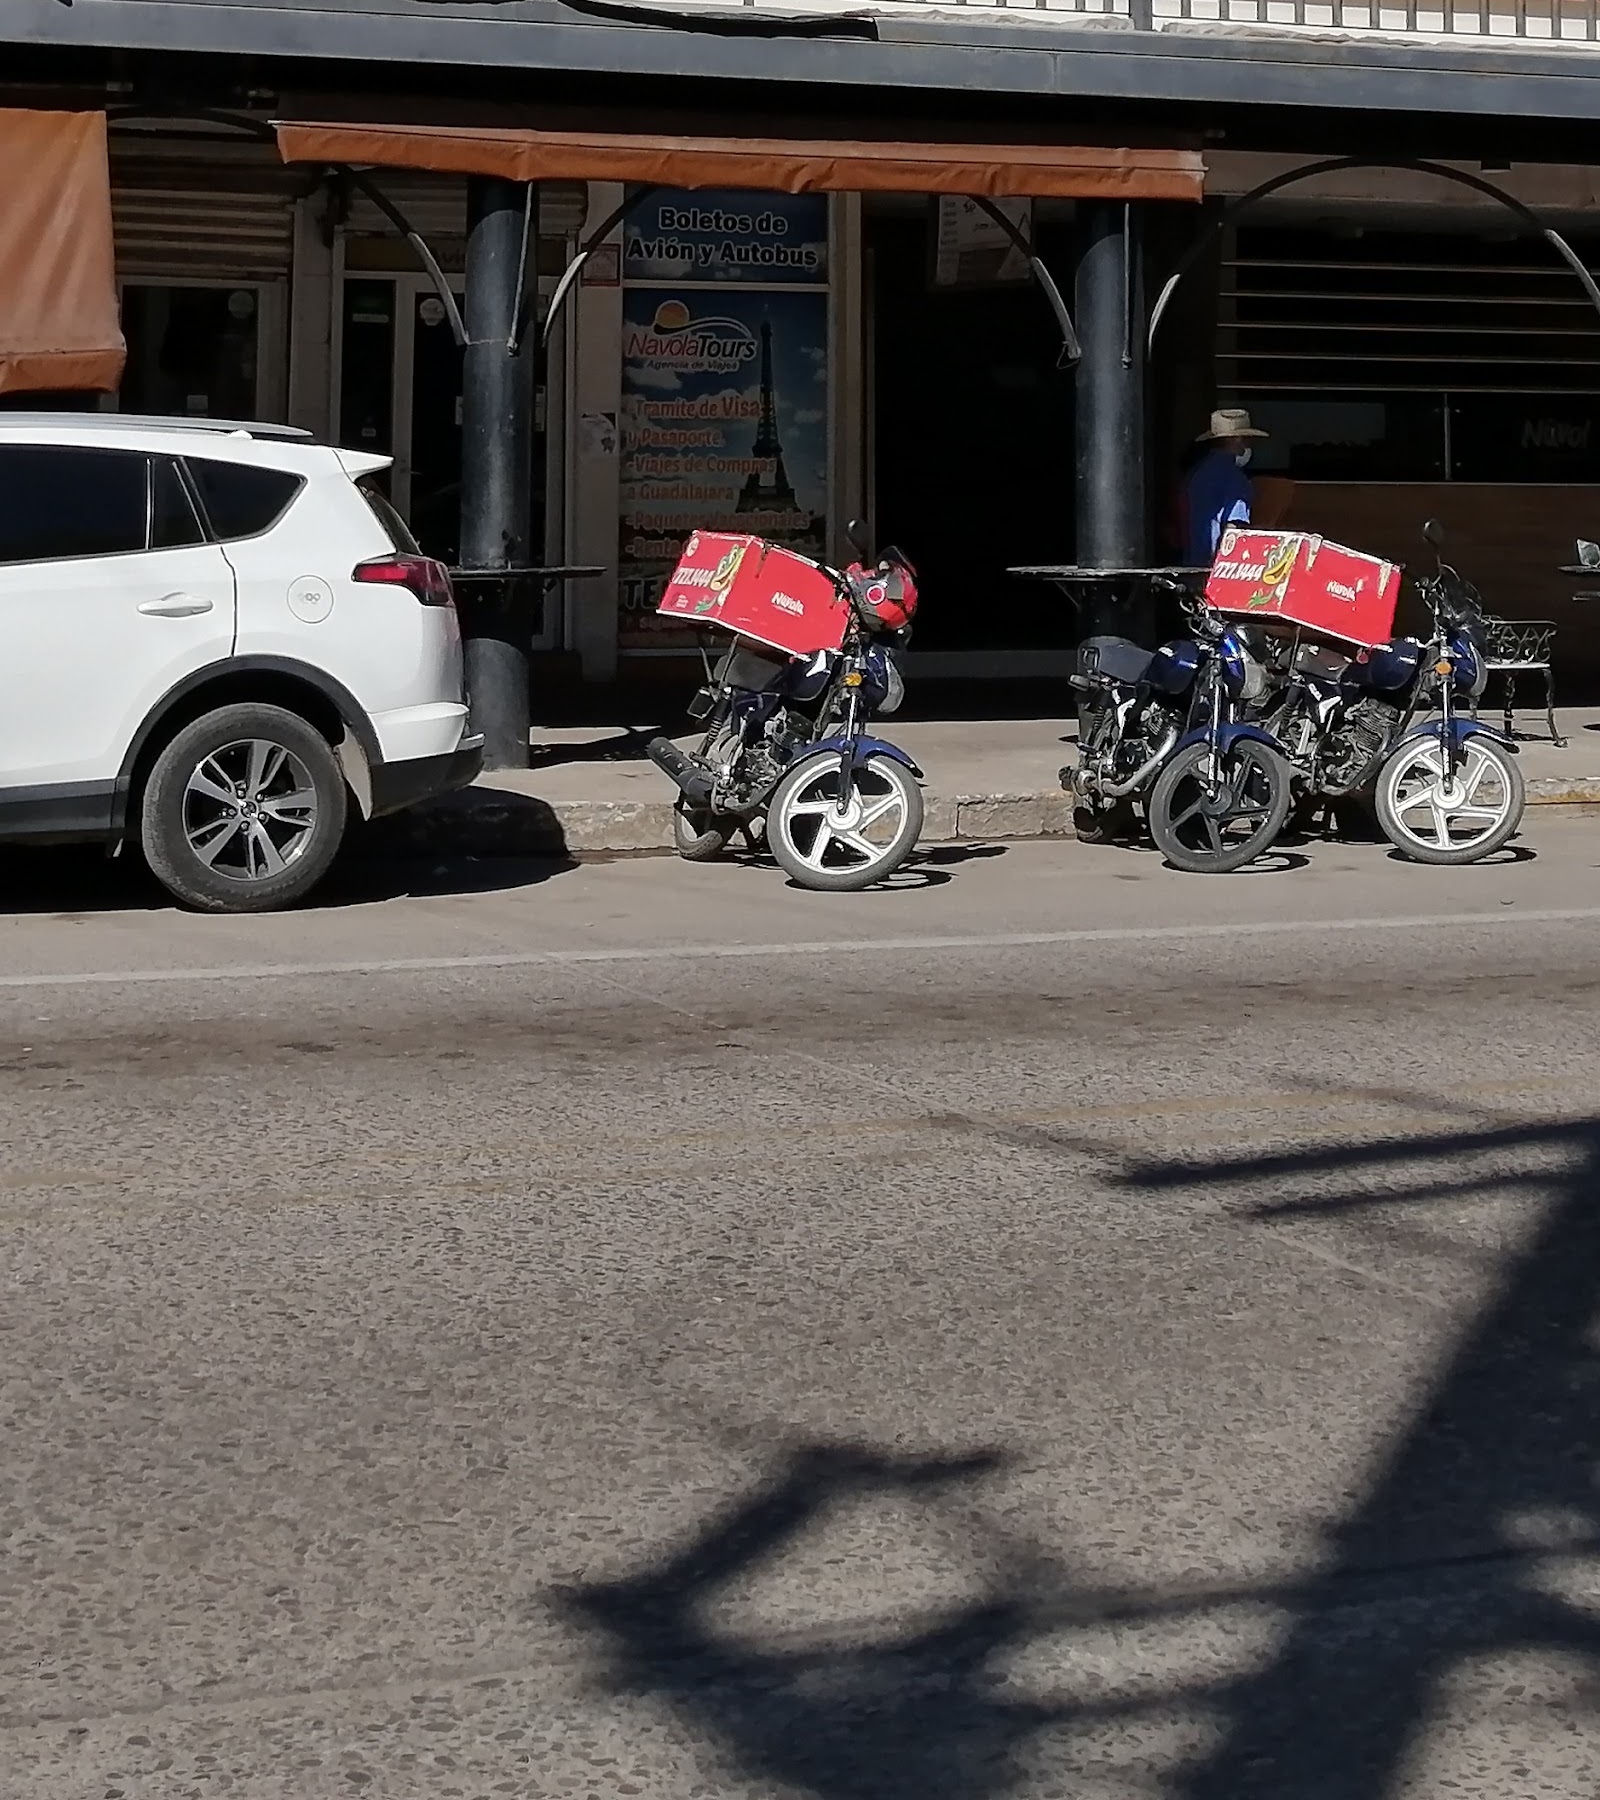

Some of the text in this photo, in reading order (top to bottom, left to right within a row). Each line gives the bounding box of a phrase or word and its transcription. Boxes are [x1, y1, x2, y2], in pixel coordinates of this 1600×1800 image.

[661, 209, 787, 233] Boletos de
[628, 238, 817, 265] Avión y Autobus
[700, 401, 718, 417] de
[721, 396, 761, 417] Visa
